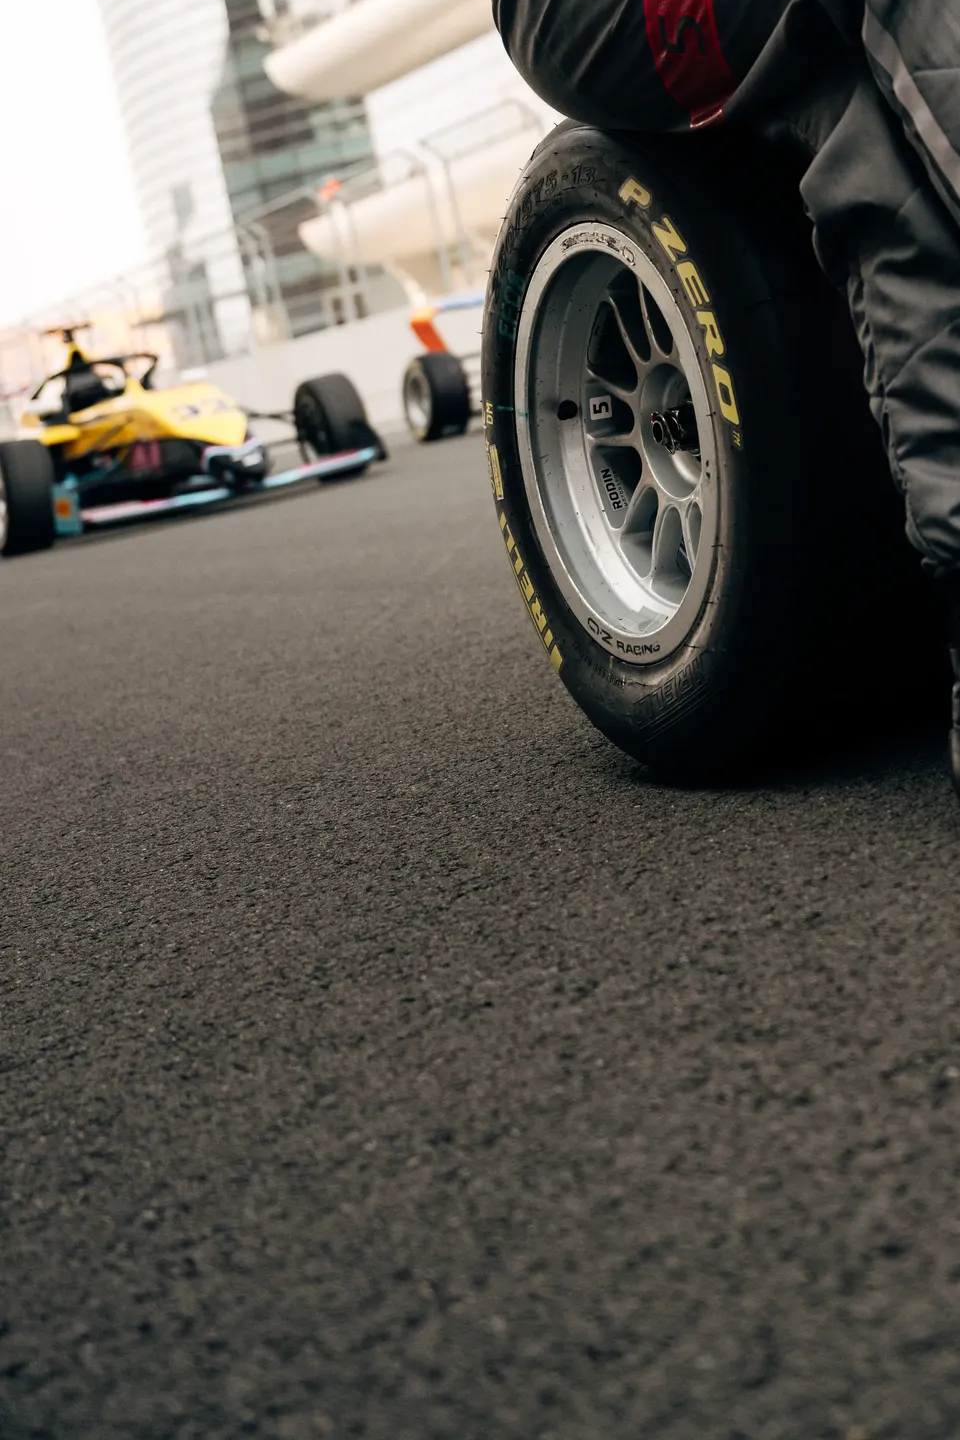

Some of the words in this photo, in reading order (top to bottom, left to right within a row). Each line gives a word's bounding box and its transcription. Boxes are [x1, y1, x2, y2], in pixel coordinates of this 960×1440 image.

[618, 175, 653, 211] P
[650, 215, 741, 426] ZERO
[593, 401, 609, 415] 5
[601, 468, 623, 510] RODIN
[616, 638, 662, 656] RACING
